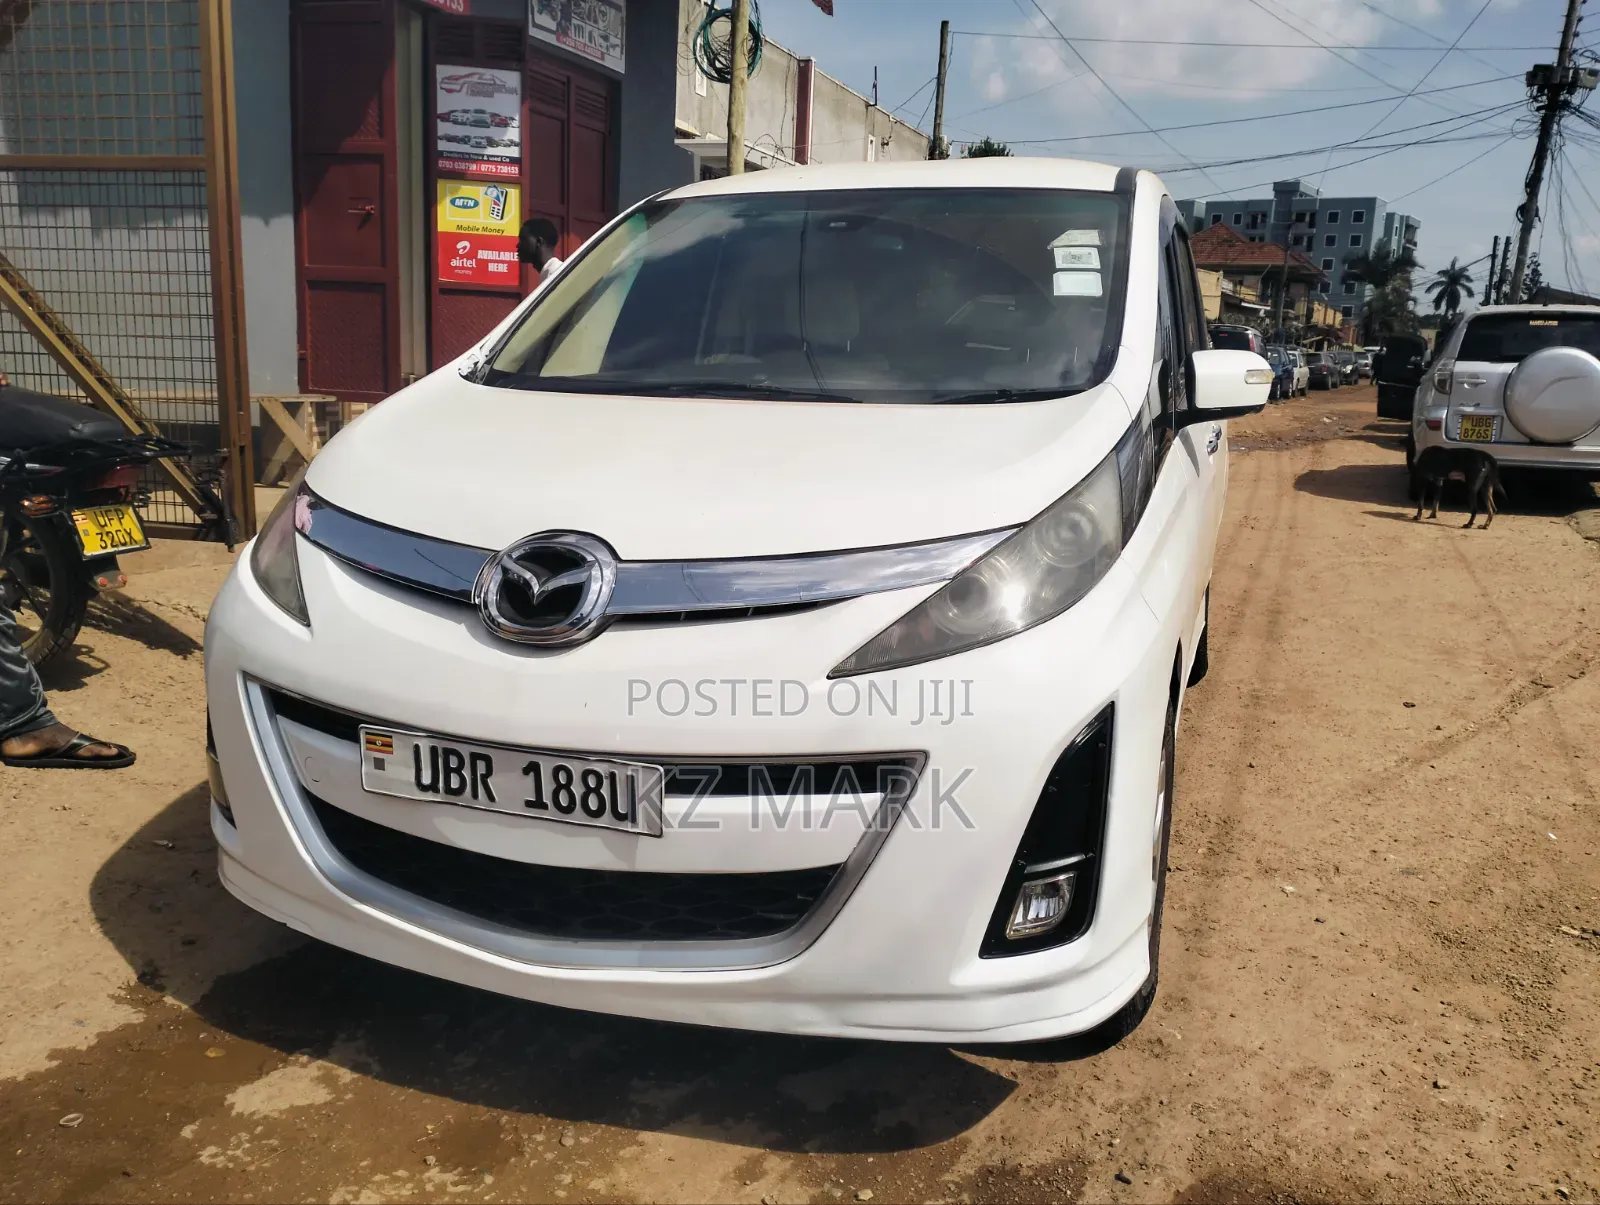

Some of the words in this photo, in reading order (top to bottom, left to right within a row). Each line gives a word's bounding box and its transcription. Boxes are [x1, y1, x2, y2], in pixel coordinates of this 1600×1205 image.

[480, 163, 496, 172] 0775
[454, 198, 475, 207] MTN
[455, 224, 480, 232] Mobile
[481, 226, 505, 235] Money
[477, 249, 519, 261] AVAILABLE
[450, 257, 477, 268] airtel
[488, 262, 509, 272] HERE
[1471, 416, 1492, 428] UBG
[1463, 427, 1490, 439] 876S
[93, 507, 125, 528] UFP
[413, 742, 497, 804] UBR
[521, 759, 638, 824] 188U
